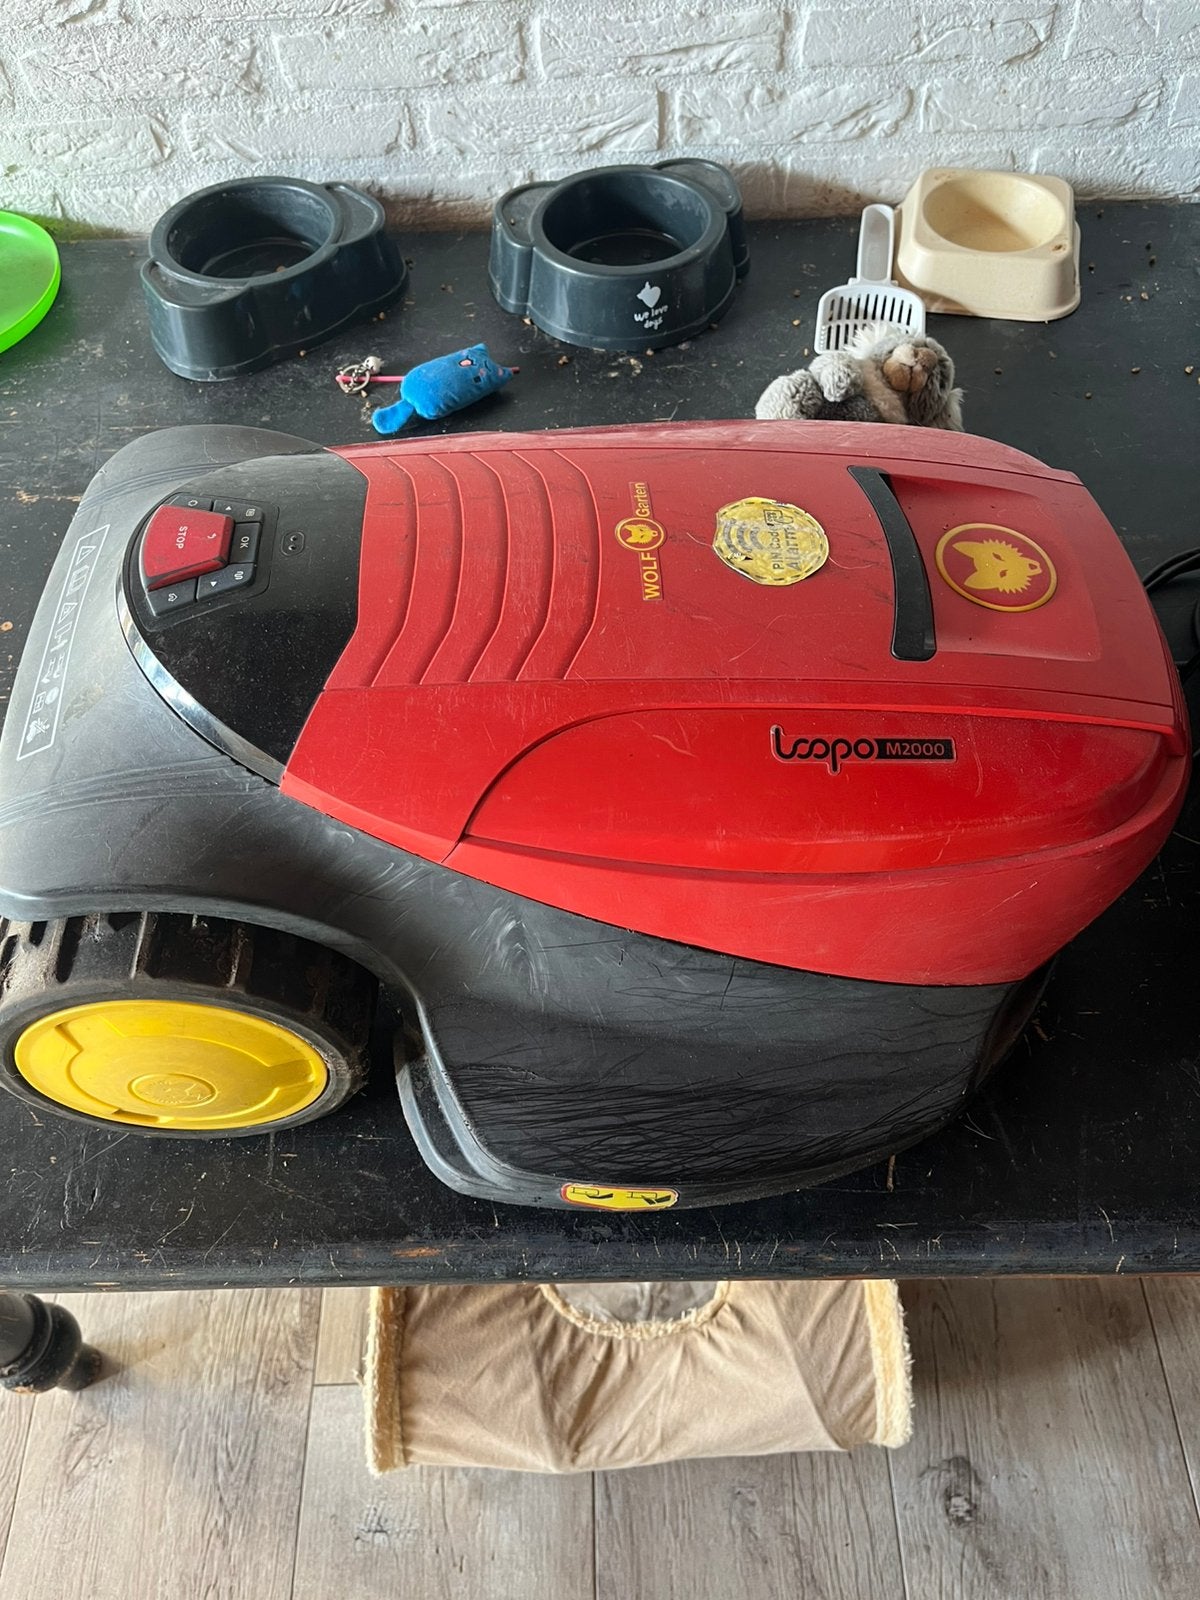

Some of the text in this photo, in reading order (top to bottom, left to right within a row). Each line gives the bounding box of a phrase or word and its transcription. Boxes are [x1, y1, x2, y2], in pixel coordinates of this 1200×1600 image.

[651, 305, 668, 317] love
[644, 317, 663, 330] dogs
[175, 526, 188, 549] STOP
[240, 536, 250, 548] OK
[634, 482, 661, 599] WOLF Garten
[771, 552, 784, 570] PIN
[885, 742, 945, 757] M2000
